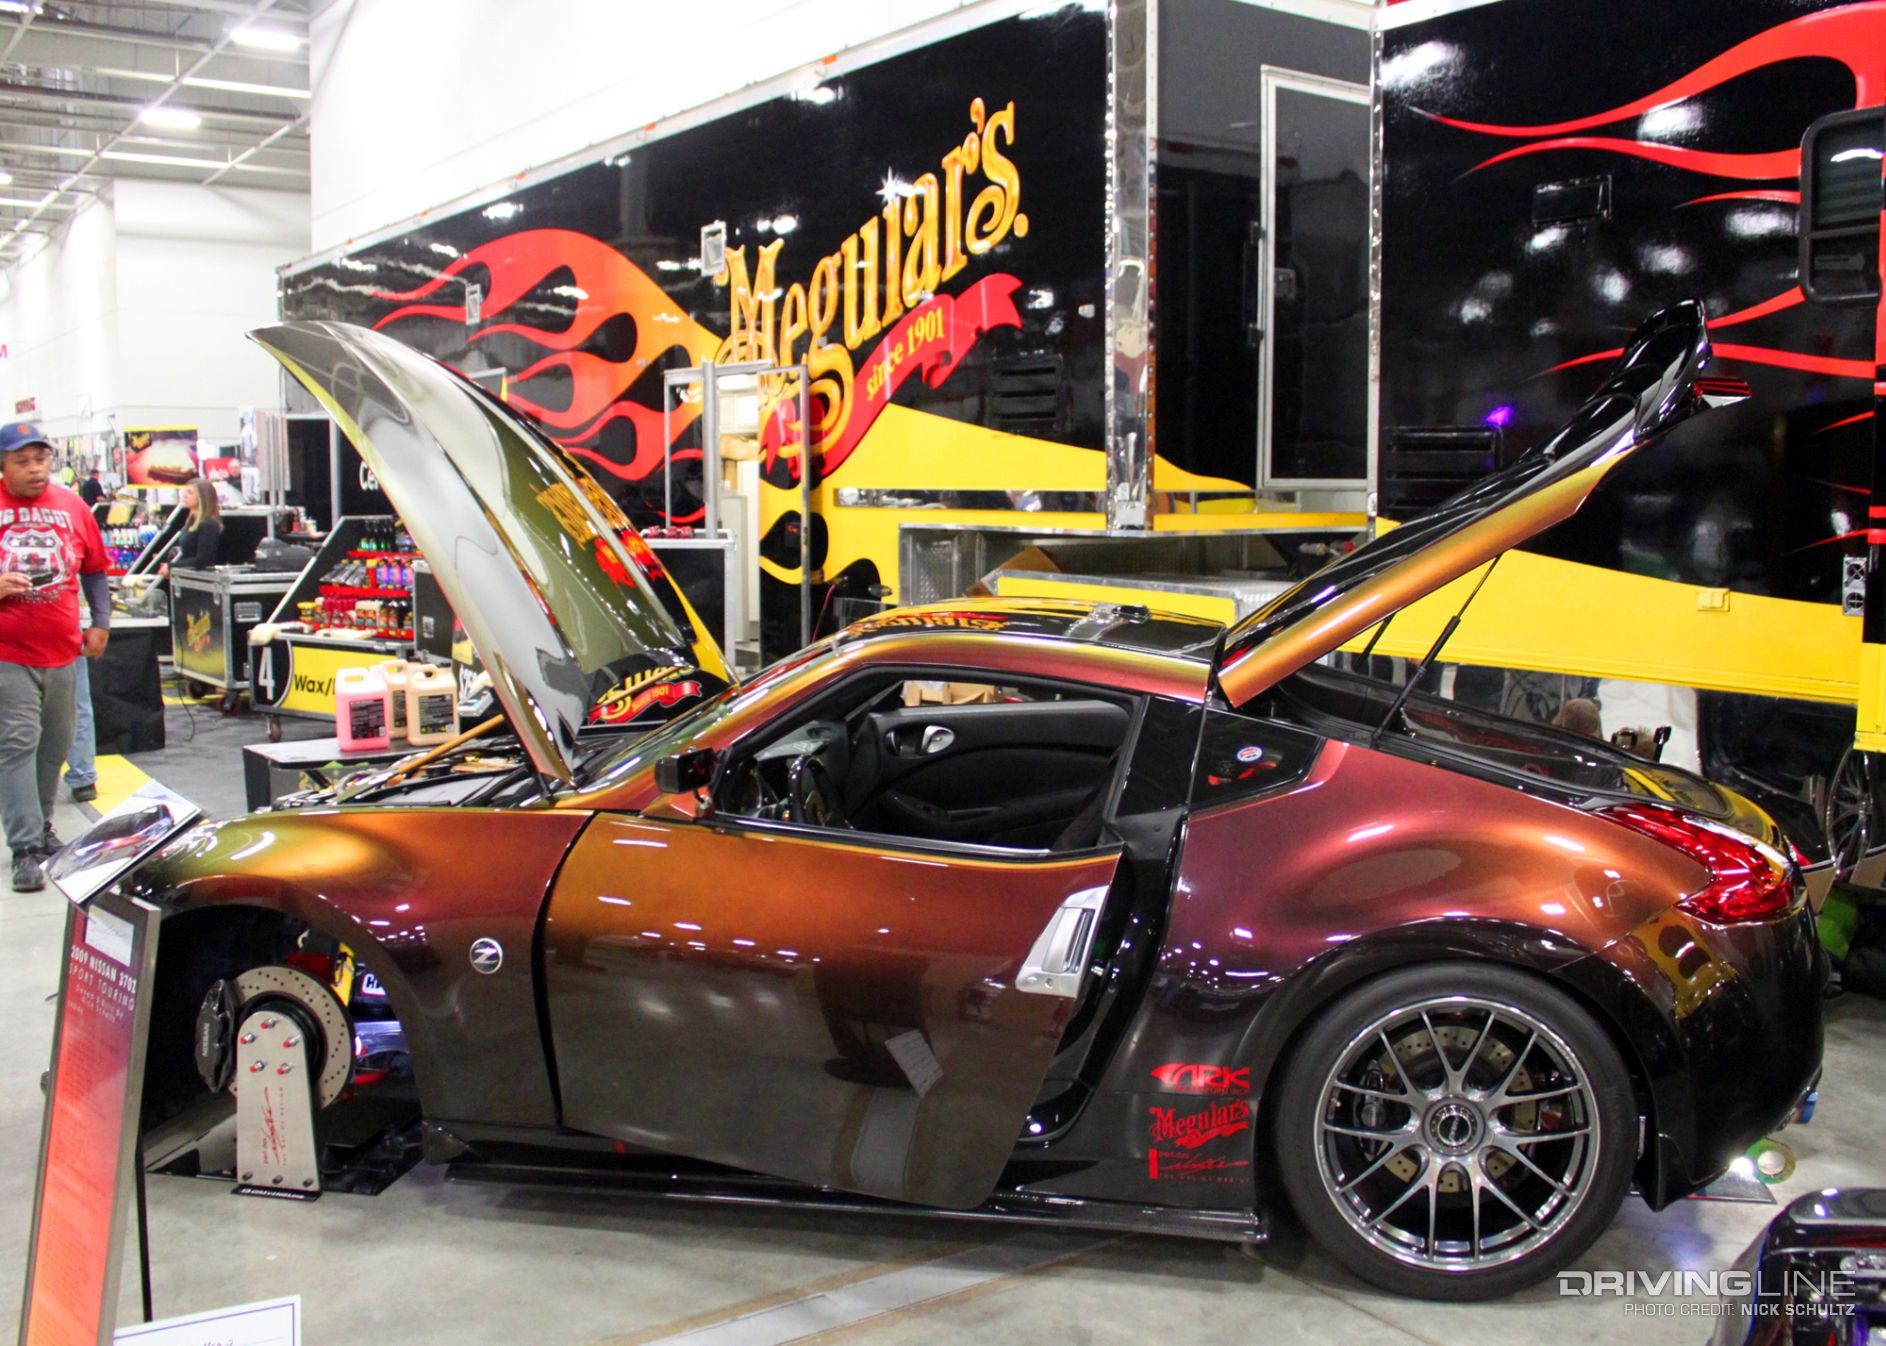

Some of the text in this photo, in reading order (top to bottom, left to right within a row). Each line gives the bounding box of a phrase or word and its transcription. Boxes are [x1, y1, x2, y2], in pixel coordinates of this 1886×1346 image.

[866, 306, 944, 401] since 1901
[258, 647, 276, 700] 4
[69, 963, 94, 986] SPORT
[98, 979, 135, 1011] TOURING
[89, 955, 117, 982] NISSAN
[118, 972, 137, 995] 370Z
[1171, 1065, 1250, 1089] ARK
